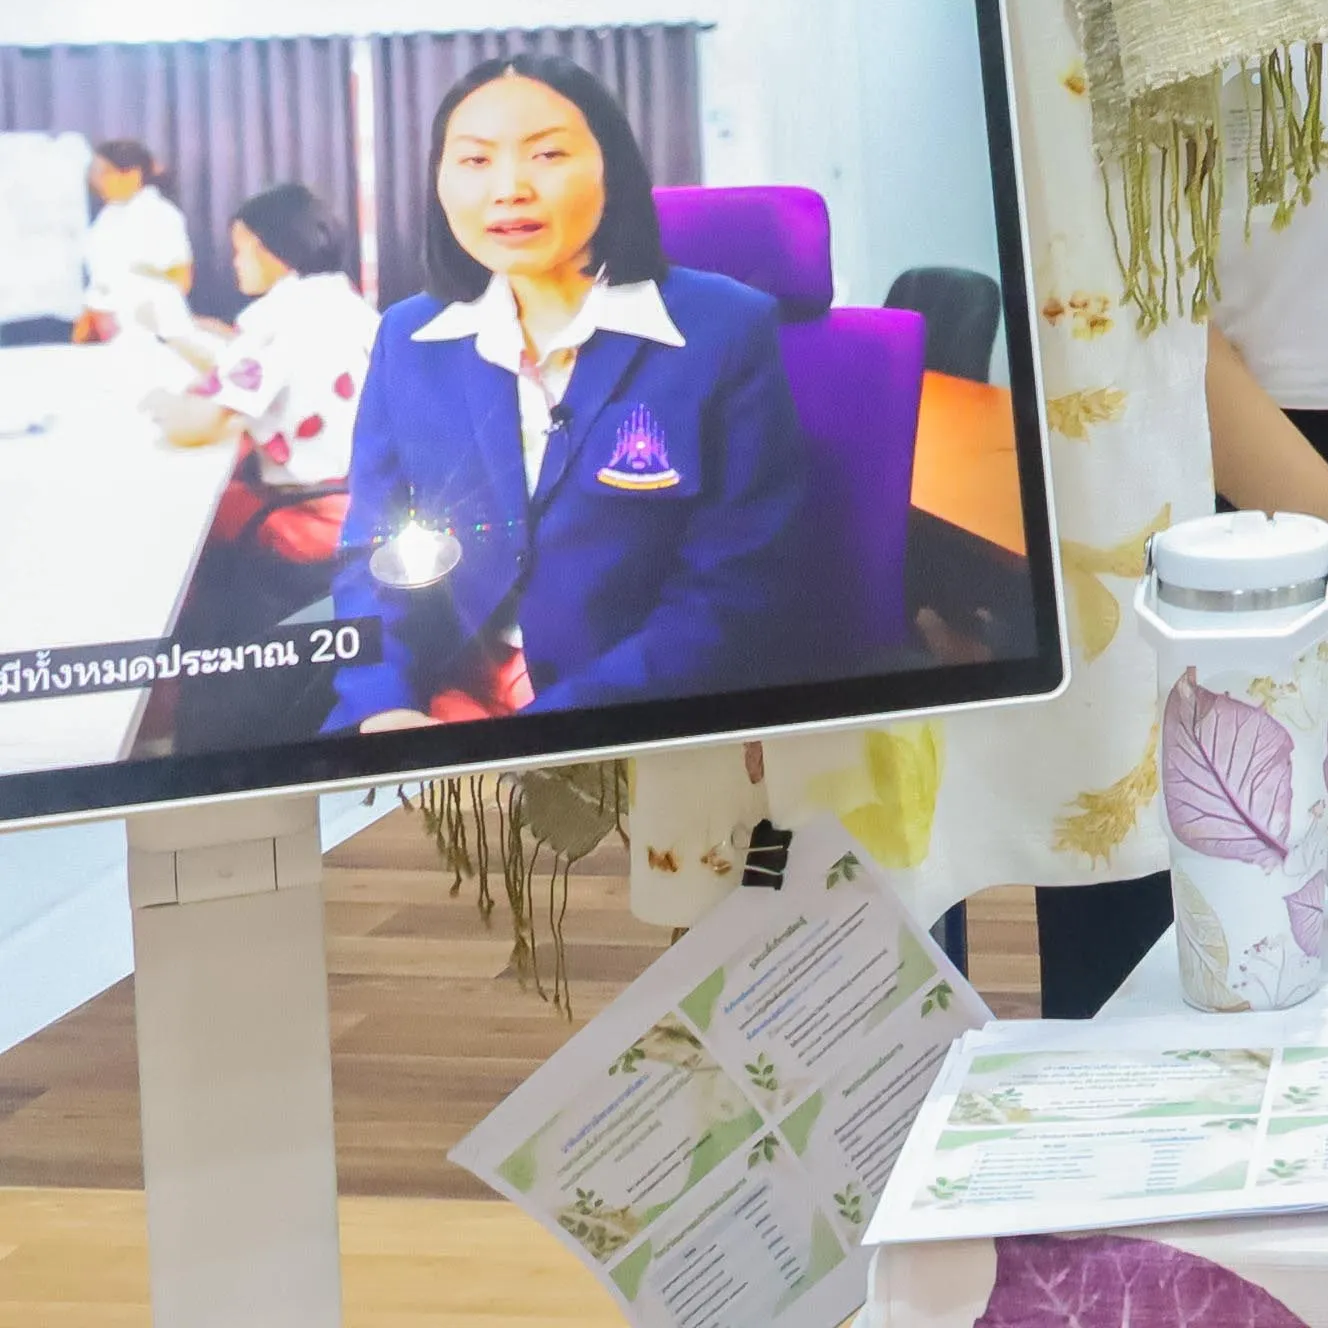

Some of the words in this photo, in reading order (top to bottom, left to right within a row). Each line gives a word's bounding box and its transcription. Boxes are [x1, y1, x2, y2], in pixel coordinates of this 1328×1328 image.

[0, 639, 299, 695] มีทั้งหมดประมาณ
[309, 626, 361, 663] 20
